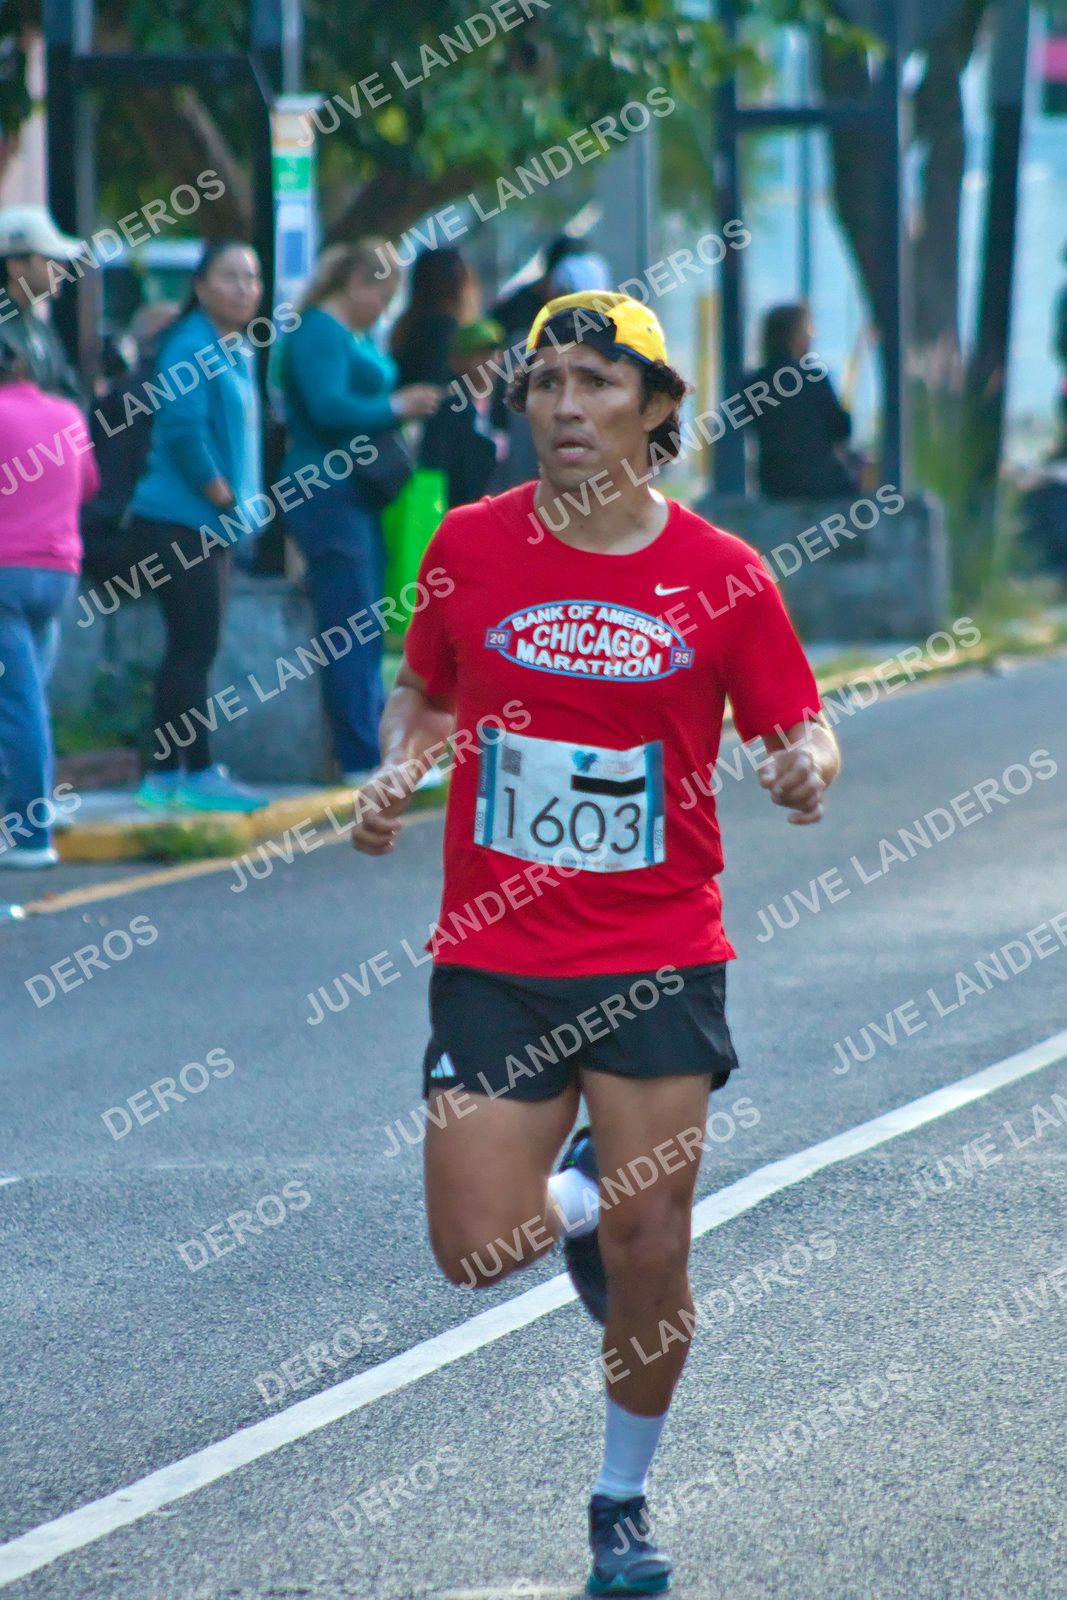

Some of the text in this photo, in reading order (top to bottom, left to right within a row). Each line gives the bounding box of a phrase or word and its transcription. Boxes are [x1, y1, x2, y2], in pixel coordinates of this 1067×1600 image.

[489, 633, 505, 644] 20
[512, 605, 673, 647] BANK OF AMERICA
[533, 622, 649, 657] CHICAGO
[516, 639, 661, 677] MARATHON
[674, 653, 689, 664] 25
[504, 786, 641, 854] 1603
